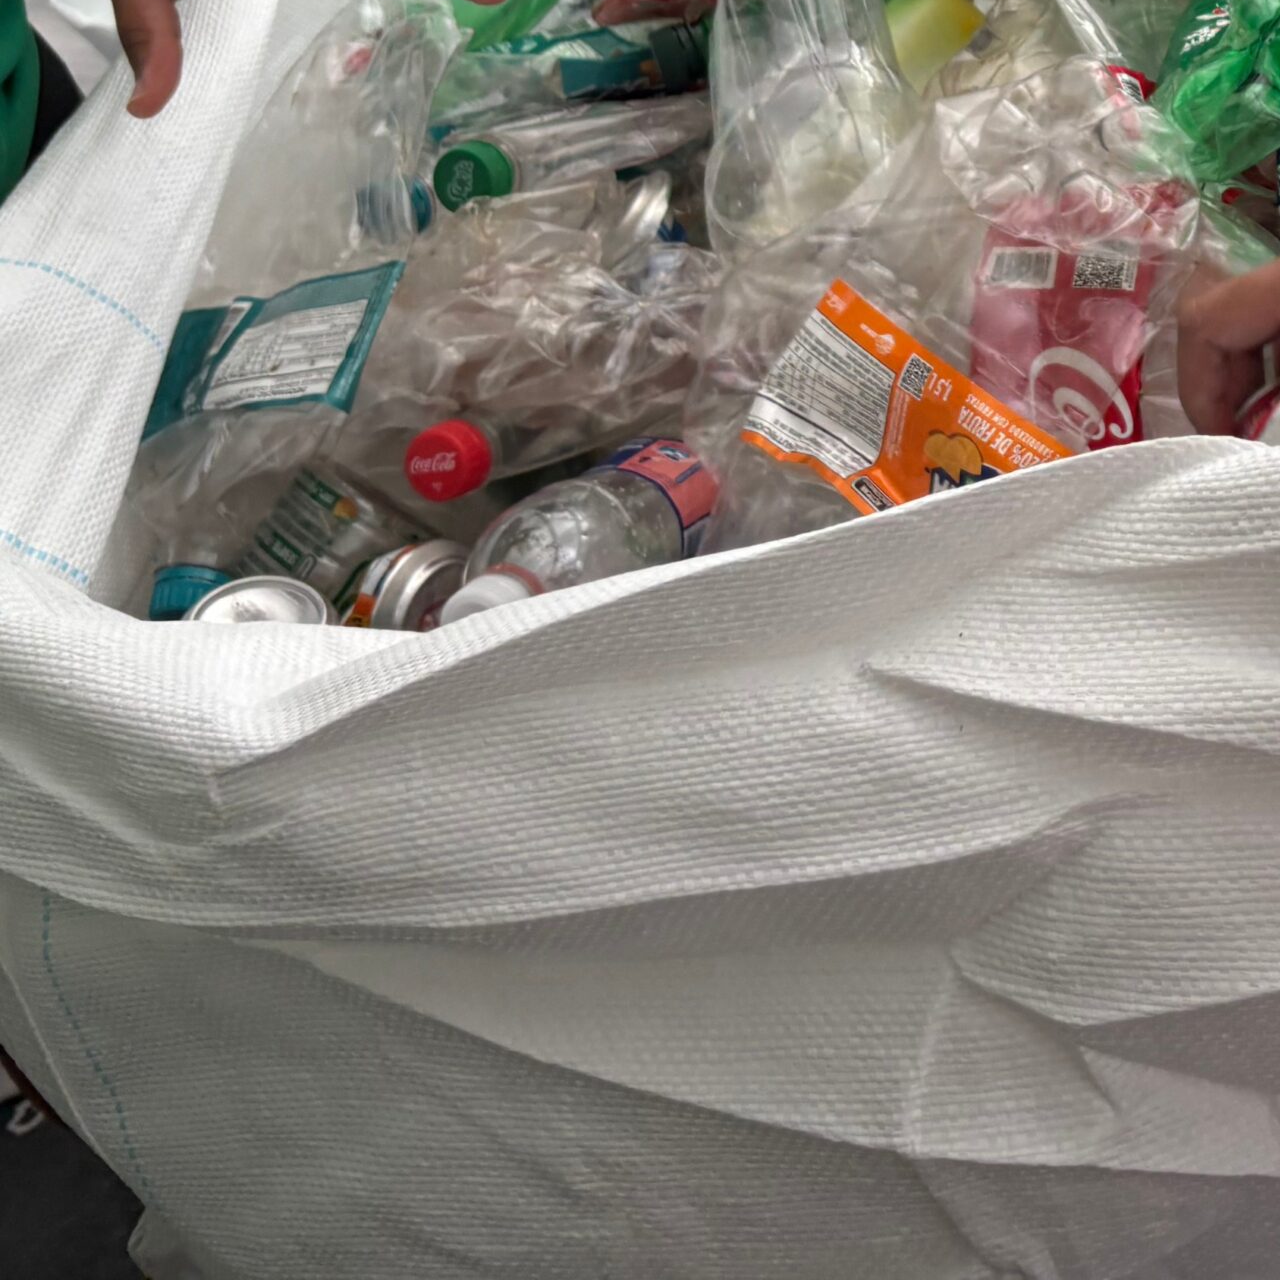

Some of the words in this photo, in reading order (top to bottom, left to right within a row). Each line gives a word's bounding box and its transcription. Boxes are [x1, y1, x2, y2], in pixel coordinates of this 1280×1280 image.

[957, 405, 997, 443] FRUTA
[989, 431, 1014, 456] DE
[411, 452, 456, 474] Coca-Cola
